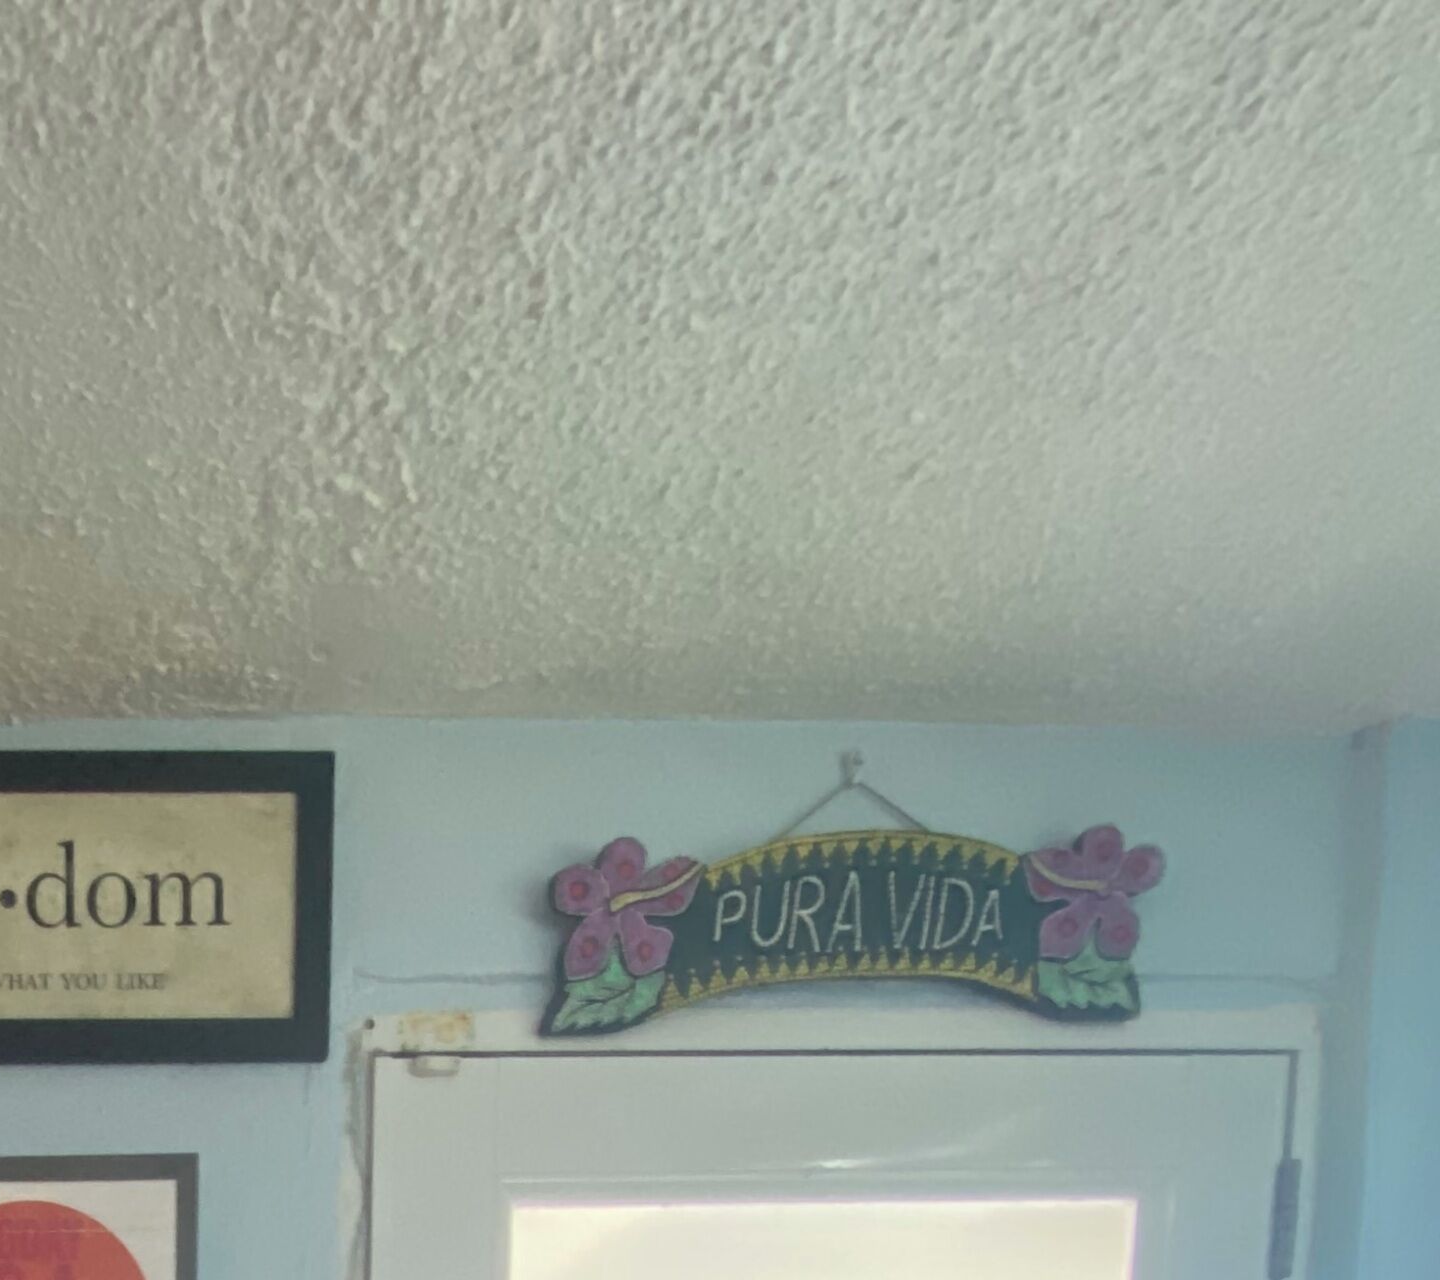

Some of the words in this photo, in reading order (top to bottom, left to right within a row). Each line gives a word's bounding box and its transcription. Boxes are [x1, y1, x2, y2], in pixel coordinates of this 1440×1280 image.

[713, 871, 863, 953] PURA
[889, 871, 1004, 950] VIDA
[62, 972, 107, 991] YOU
[116, 972, 167, 991] LIKE
